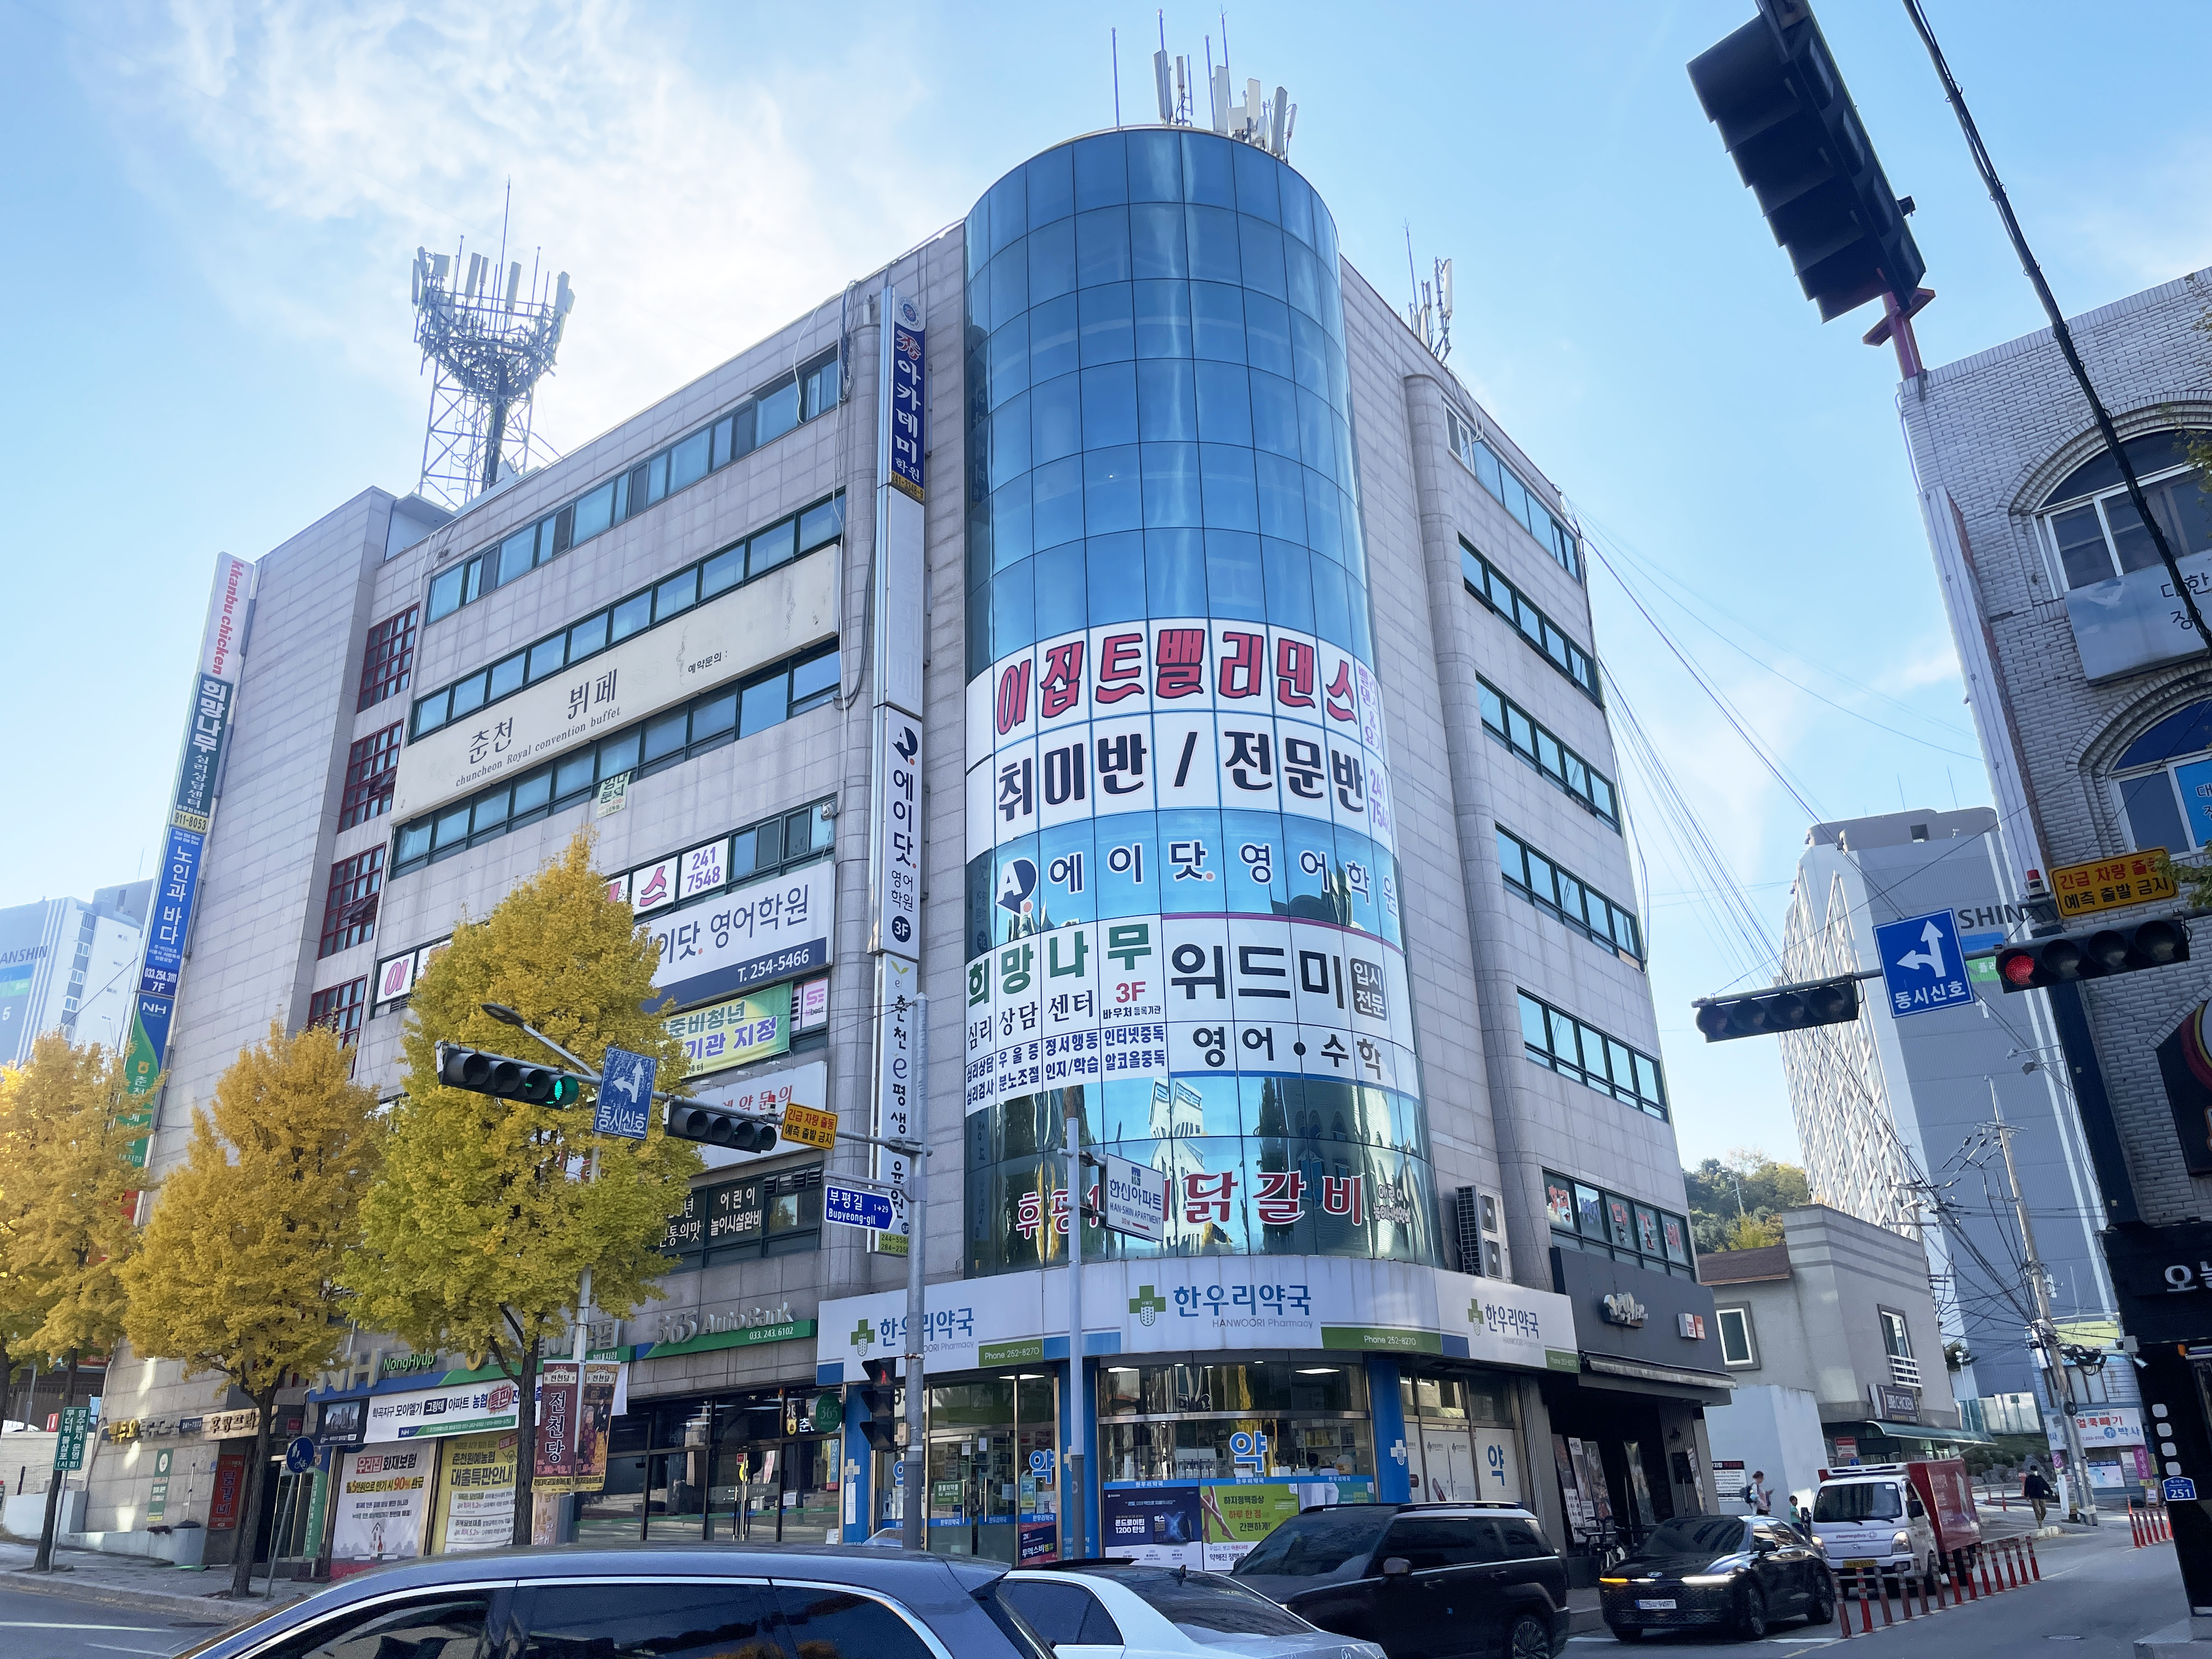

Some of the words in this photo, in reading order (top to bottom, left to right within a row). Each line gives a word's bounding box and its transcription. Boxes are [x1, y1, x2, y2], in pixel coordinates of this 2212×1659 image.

[224, 560, 245, 614] kkanbu
[212, 616, 233, 675] chicken
[688, 651, 723, 674] 예약문의
[193, 680, 227, 753] 희망나무
[469, 716, 514, 765] 춘천
[567, 668, 619, 721] 뷔페
[456, 760, 503, 787] chuncheon
[506, 744, 532, 764] Royal
[535, 723, 586, 753] convention
[590, 706, 621, 727] buffet
[999, 733, 1147, 822] 취미반
[1225, 731, 1364, 812] 전문반
[601, 784, 625, 804] 문의
[174, 812, 206, 830] 911-8053
[692, 845, 716, 871] 241
[167, 845, 193, 902] 노인과
[687, 866, 721, 893] 7548
[2058, 872, 2091, 890] 긴급
[2096, 864, 2126, 884] 차량
[2064, 890, 2095, 910] 예측
[2101, 884, 2131, 902] 출발
[2137, 876, 2169, 895] 금지
[159, 906, 182, 945] 바다
[710, 884, 810, 951] 영어학원
[894, 921, 909, 937] 3F
[0, 945, 48, 964] ANSHIN
[750, 947, 810, 979] 254-5466
[969, 923, 1152, 1008] 희망나무
[152, 981, 165, 992] 7F
[1171, 944, 1345, 1009] 위드미
[1353, 961, 1383, 991] 입시
[1116, 981, 1146, 1003] 3F
[1356, 990, 1386, 1019] 전문
[1895, 980, 1966, 1009] 동시신호
[142, 1002, 167, 1015] NH
[661, 1000, 746, 1039] 준비청년
[1103, 1007, 1132, 1020] 바우처
[733, 1016, 777, 1049] 지정
[967, 1056, 994, 1084] 심리상담
[1046, 1031, 1098, 1057] 정서행동
[1104, 1025, 1165, 1047] 인터넷중독
[967, 1078, 994, 1106] 심리검사
[998, 1065, 1039, 1092] 분노조절
[1046, 1056, 1099, 1081] 인지/학습
[1105, 1049, 1165, 1071] 알코올중독
[598, 1105, 646, 1135] 동시신호
[787, 1108, 803, 1122] 긴급
[804, 1112, 819, 1126] 차량
[820, 1116, 834, 1130] 출동
[785, 1124, 800, 1137] 예측
[802, 1128, 817, 1141] 출발
[818, 1131, 833, 1146] 금지
[720, 1187, 756, 1211] 어린이
[830, 1189, 864, 1211] 부평길
[1109, 1179, 1162, 1211] 한신아파트
[1182, 1169, 1363, 1227] 닭갈비
[1378, 1183, 1403, 1203] 어린이
[710, 1210, 763, 1237] 놀이시설완비
[828, 1208, 877, 1227] Bupyeong-gil
[1110, 1201, 1134, 1217] HAN-SHIN
[1134, 1209, 1161, 1226] APARTMENT
[1173, 1284, 1312, 1317] 한우리약국
[655, 1311, 697, 1345] 365
[1212, 1318, 1265, 1328] HANWOORI
[1268, 1318, 1313, 1329] Pharmacy
[1485, 1304, 1539, 1339] 한우리약국
[941, 1340, 974, 1352] Pharmacy
[985, 1351, 1005, 1360] Phone
[1007, 1347, 1040, 1358] 252-8270
[1364, 1335, 1386, 1345] Phone
[1387, 1336, 1416, 1346] 252-8270
[383, 1354, 435, 1372] NongHyup
[448, 1397, 470, 1411] 아파트
[473, 1393, 488, 1409] 농협
[820, 1406, 838, 1420] 365
[545, 1391, 566, 1463] 전천당
[358, 1457, 382, 1473] 우리집
[382, 1453, 417, 1471] 화재보험
[452, 1451, 496, 1465] 춘천원예농협
[1228, 1430, 1267, 1474] 약
[450, 1465, 513, 1487] 대출특판안내
[1029, 1448, 1054, 1485] 약
[1487, 1444, 1505, 1487] 약
[376, 1479, 387, 1492] 만기
[393, 1476, 411, 1491] 90%
[2170, 1488, 2191, 1498] 251
[1223, 1495, 1265, 1505] 하지정맥증상
[1228, 1510, 1244, 1520] 하루
[1245, 1509, 1253, 1519] 한
[1254, 1509, 1261, 1519] 정
